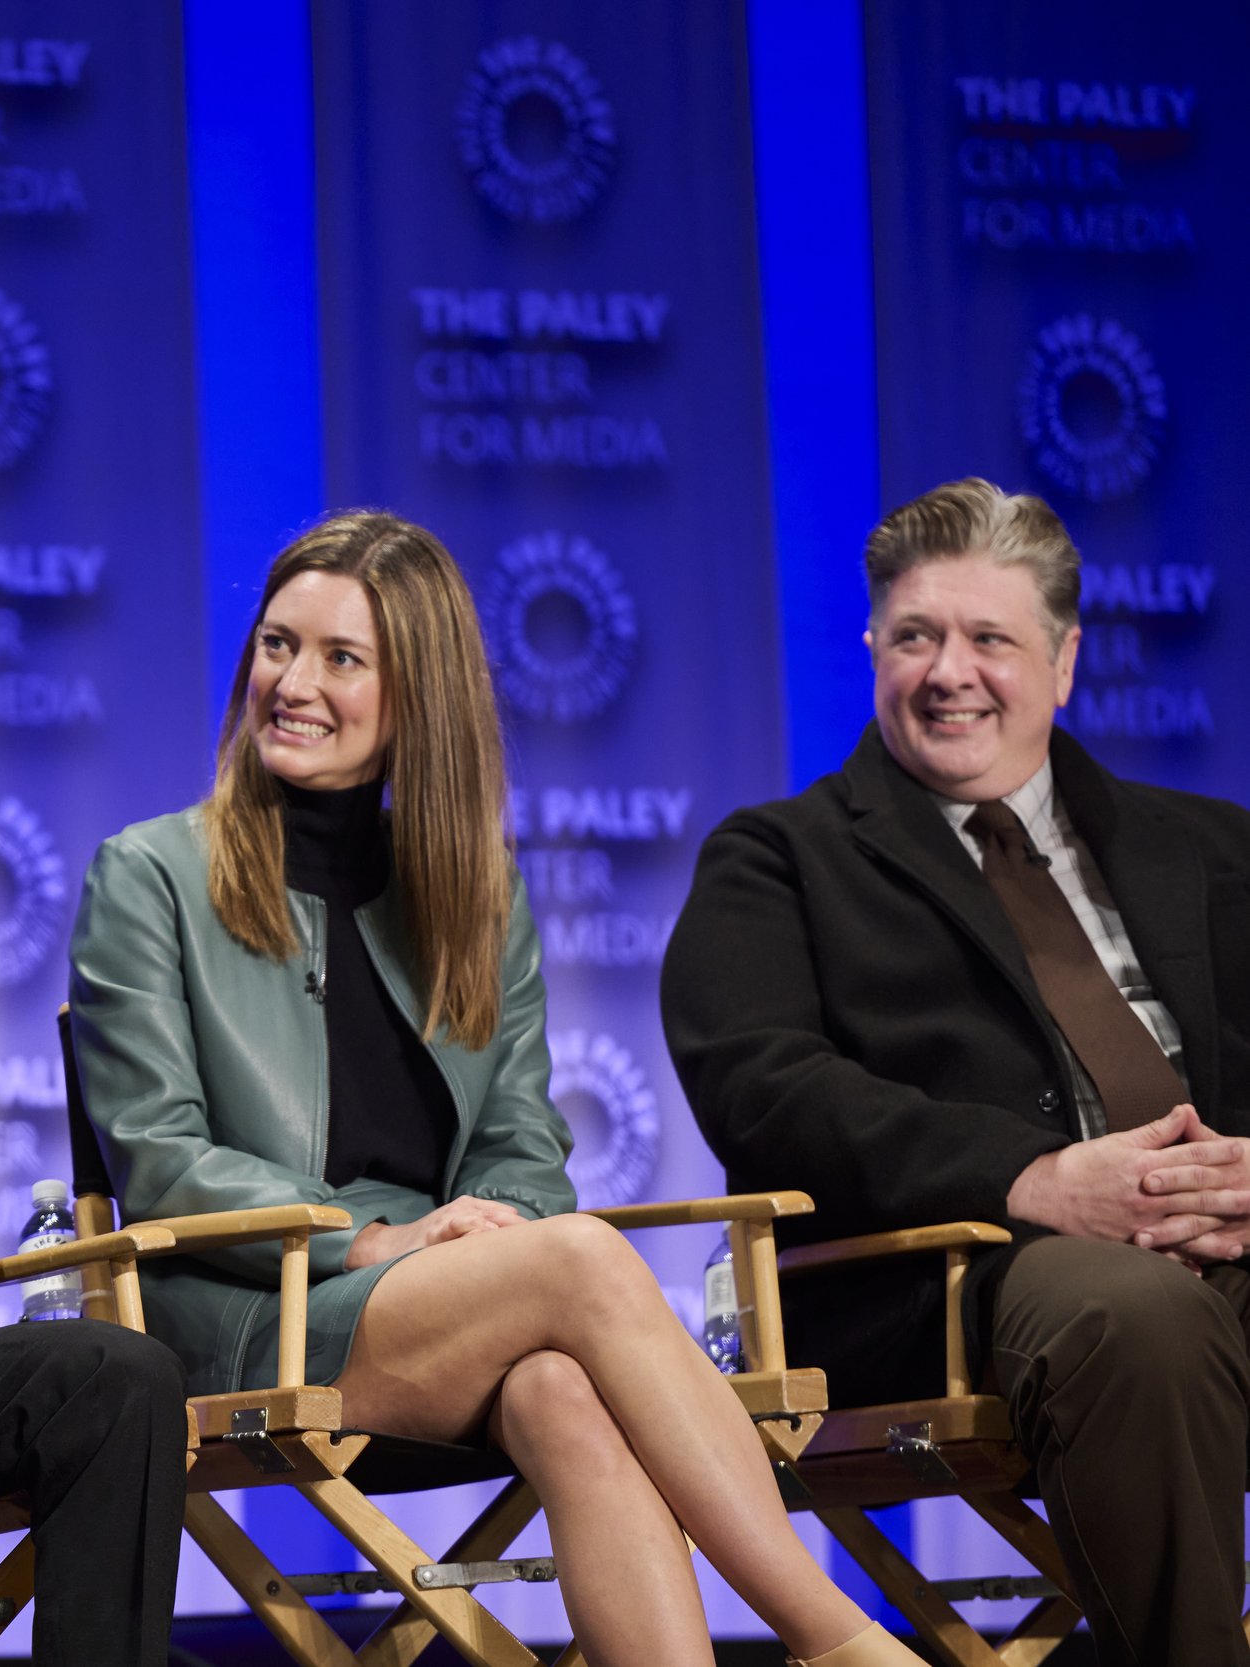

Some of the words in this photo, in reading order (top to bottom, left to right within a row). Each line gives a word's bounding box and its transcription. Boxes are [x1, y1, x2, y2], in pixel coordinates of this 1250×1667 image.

[954, 76, 1049, 123] THE
[1056, 79, 1197, 129] PALEY
[957, 137, 1126, 190] CENTER
[962, 198, 1055, 249] FOR
[1058, 202, 1197, 254] MEDIA
[409, 287, 510, 338] THE
[517, 289, 671, 343] PALEY
[413, 350, 595, 405] CENTER
[417, 411, 518, 464] FOR
[521, 414, 670, 468] MEDIA
[1079, 562, 1215, 614] PALEY
[1076, 685, 1215, 738] MEDIA
[541, 786, 694, 840] PALEY
